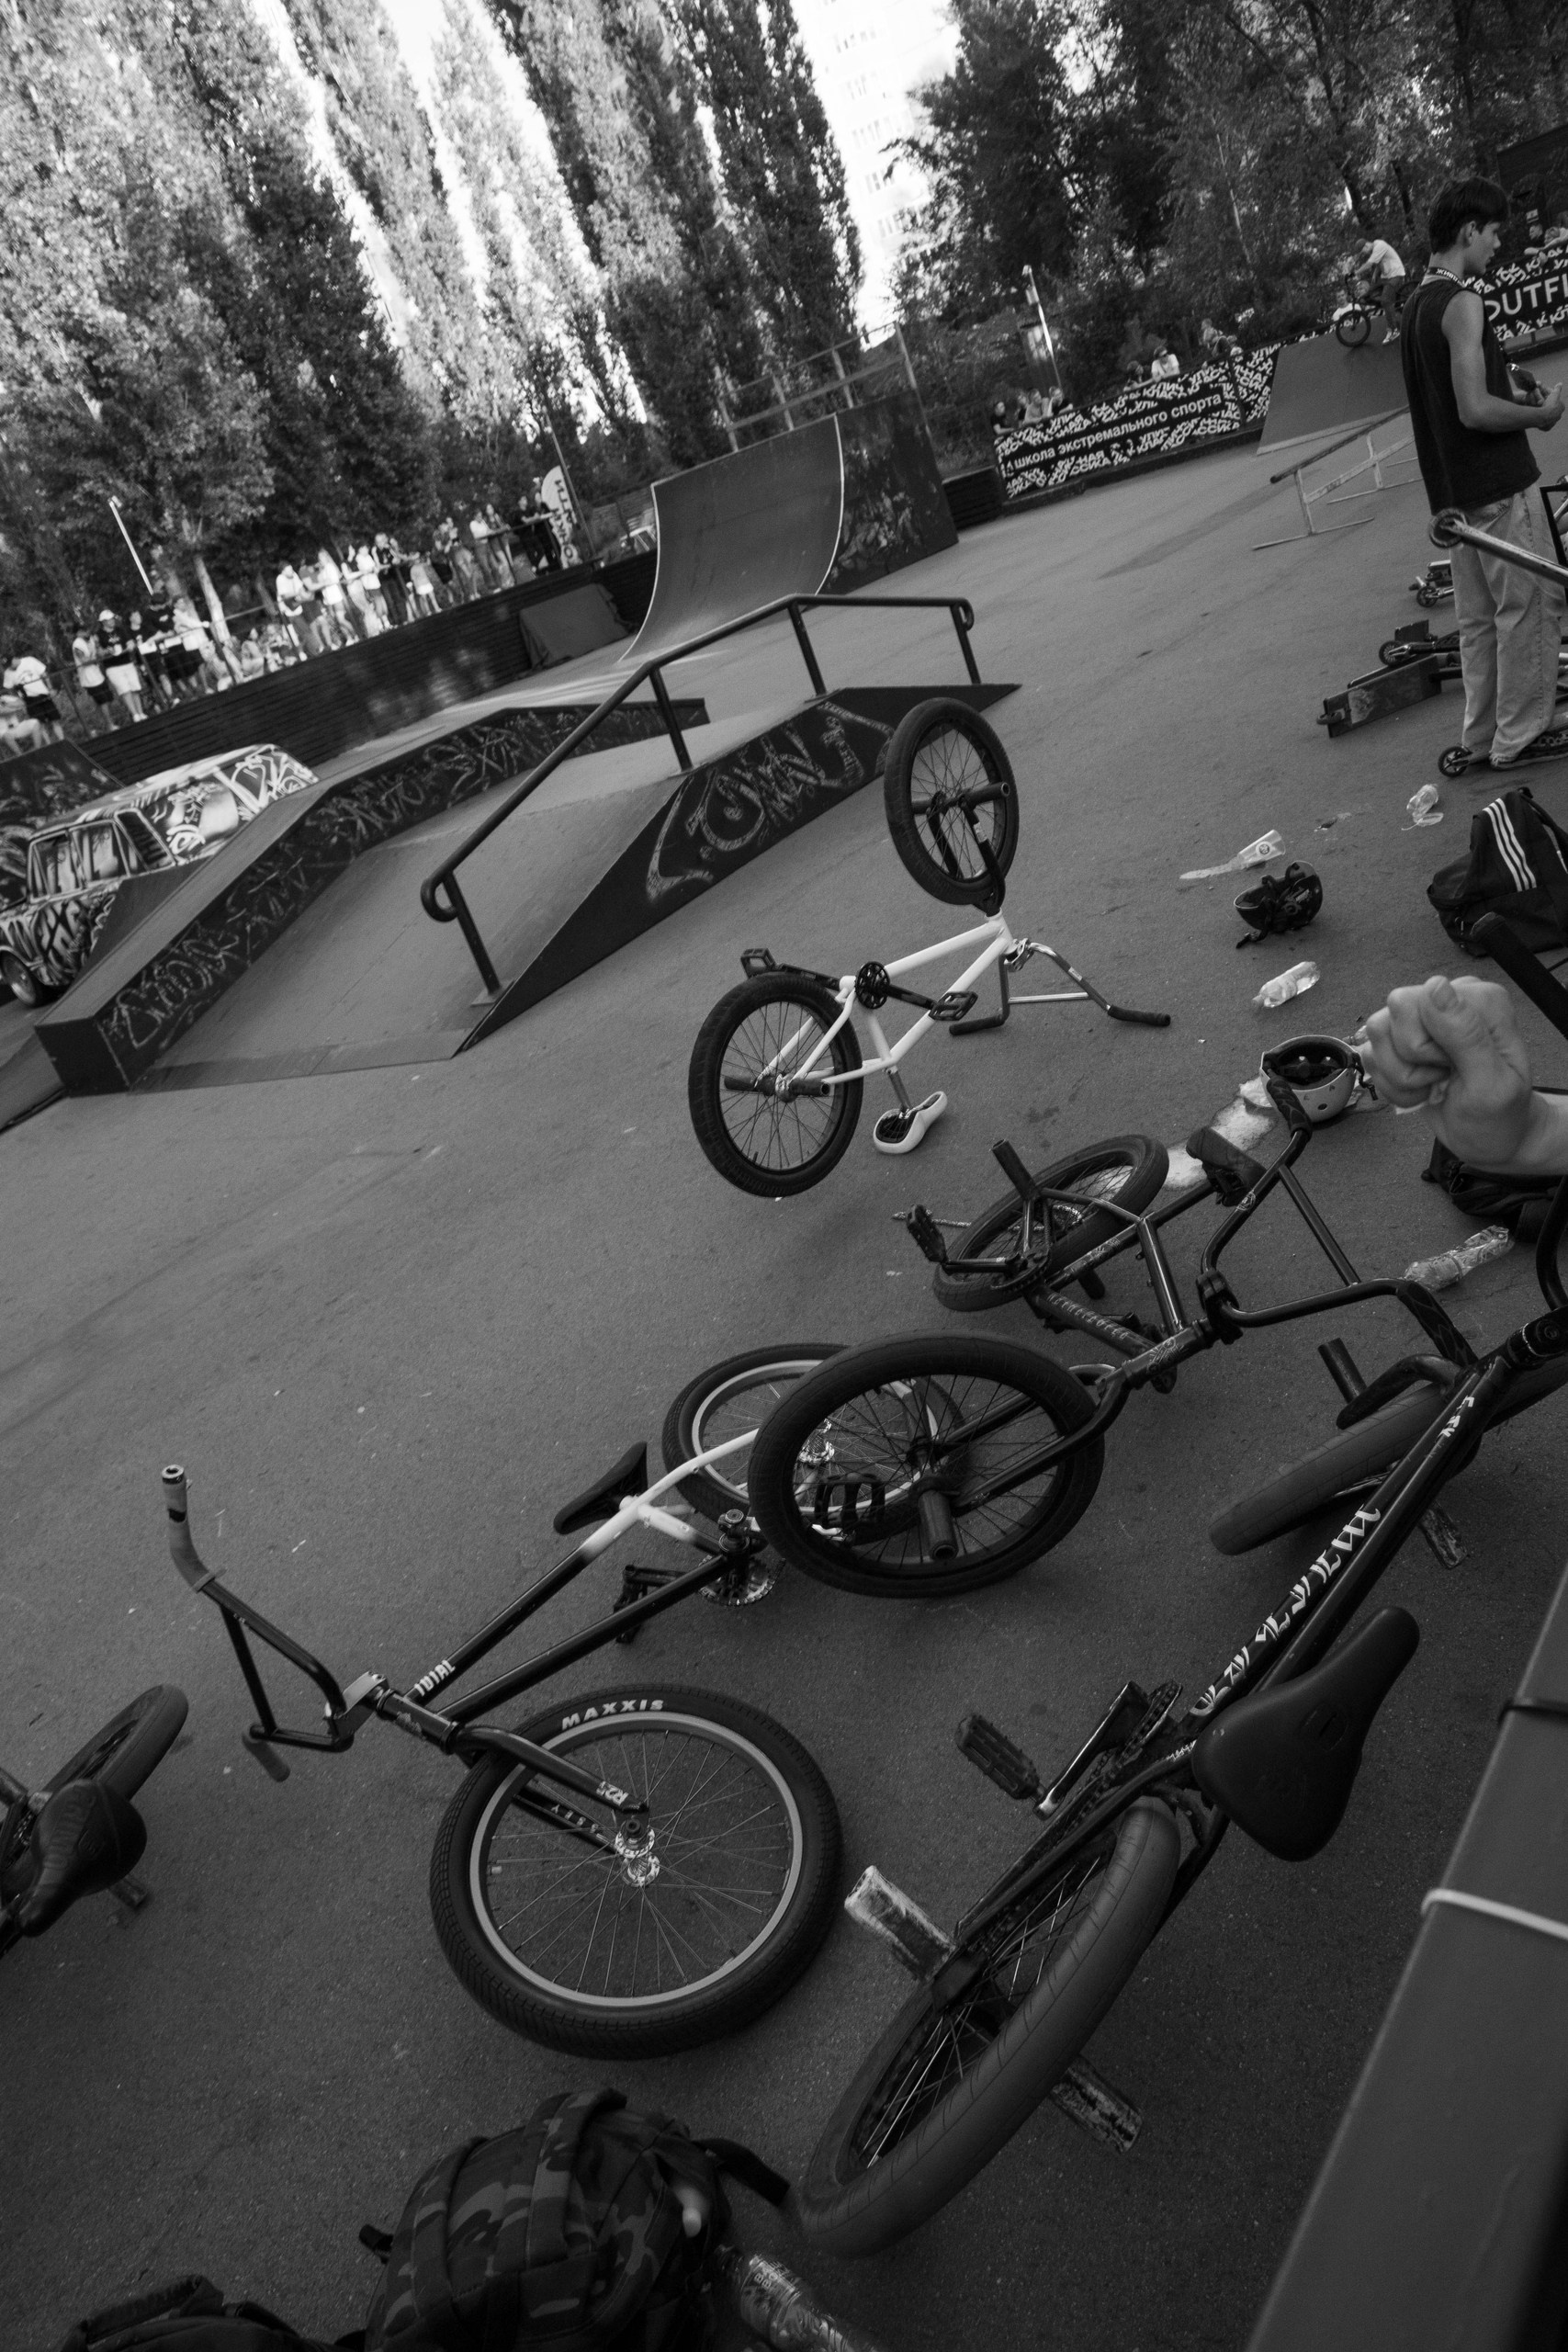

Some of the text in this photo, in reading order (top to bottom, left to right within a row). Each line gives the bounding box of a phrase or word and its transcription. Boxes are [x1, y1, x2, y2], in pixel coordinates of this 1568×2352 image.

[1015, 447, 1055, 469] школа
[1058, 412, 1168, 454] экстремального
[1171, 394, 1222, 419] спорта
[562, 1700, 664, 1729] MAXXIS
